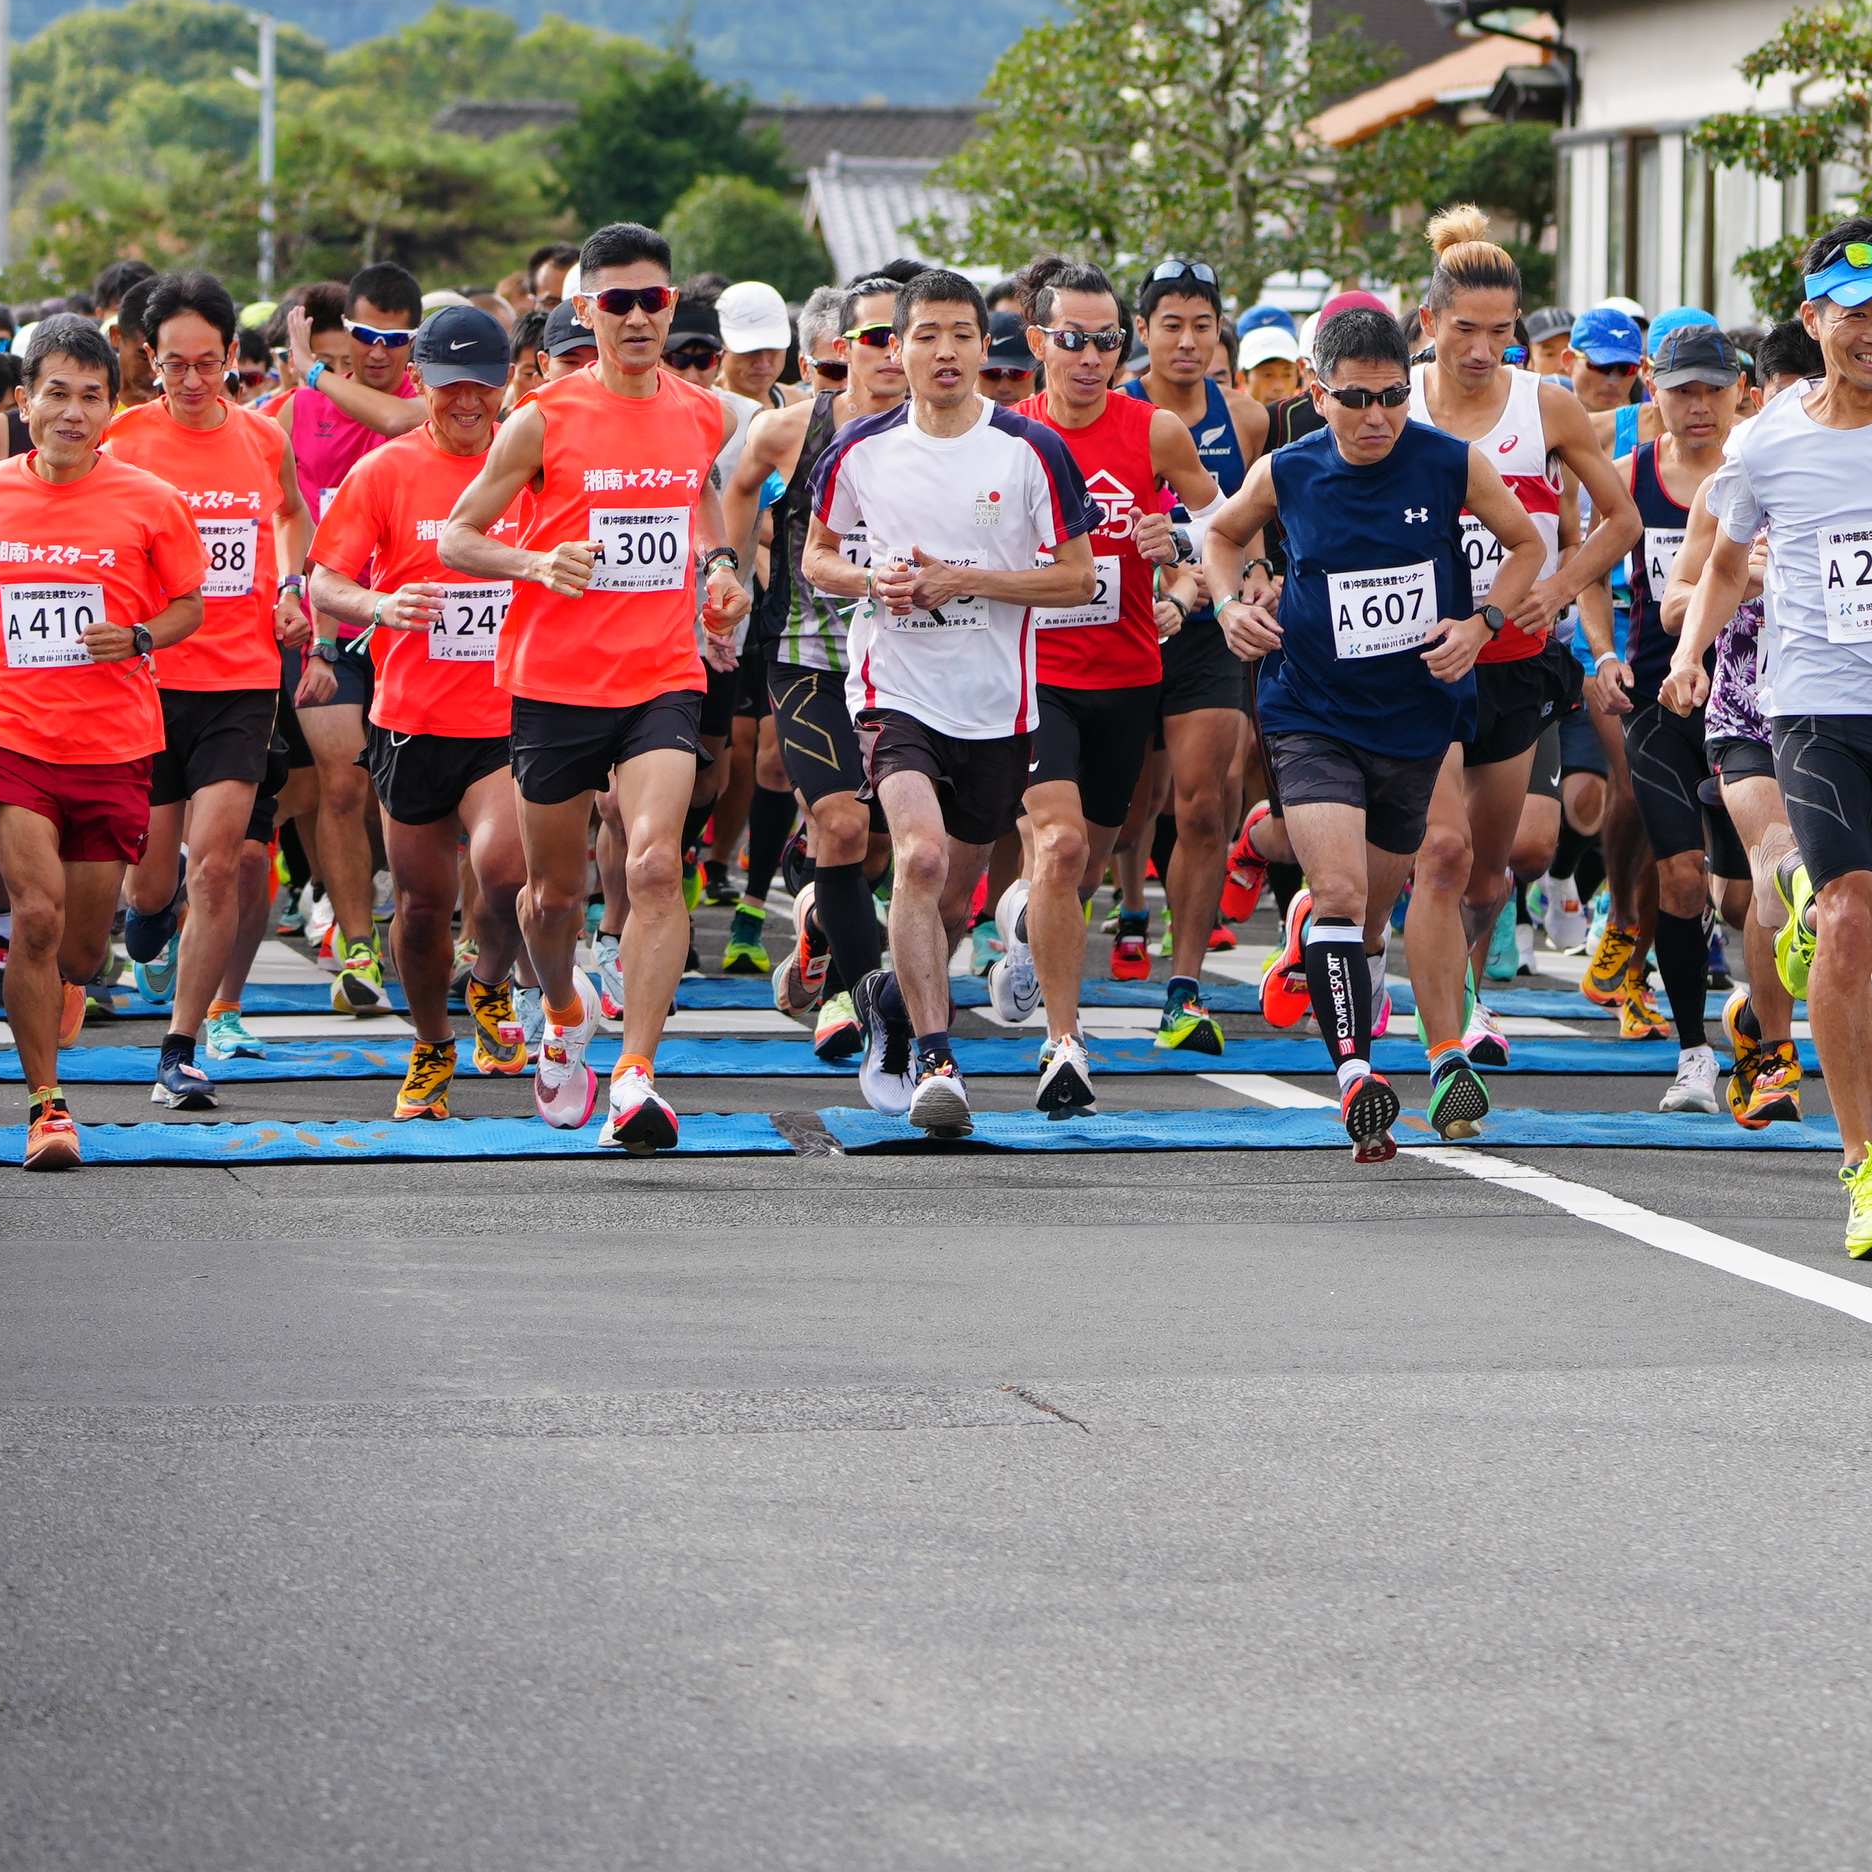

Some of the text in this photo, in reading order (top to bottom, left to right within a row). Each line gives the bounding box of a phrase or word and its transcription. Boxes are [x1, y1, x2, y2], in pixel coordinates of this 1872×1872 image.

[616, 531, 677, 566] 300
[1652, 556, 1665, 579] A
[1828, 559, 1844, 589] A
[1338, 587, 1424, 632] A 607
[8, 614, 23, 641] A
